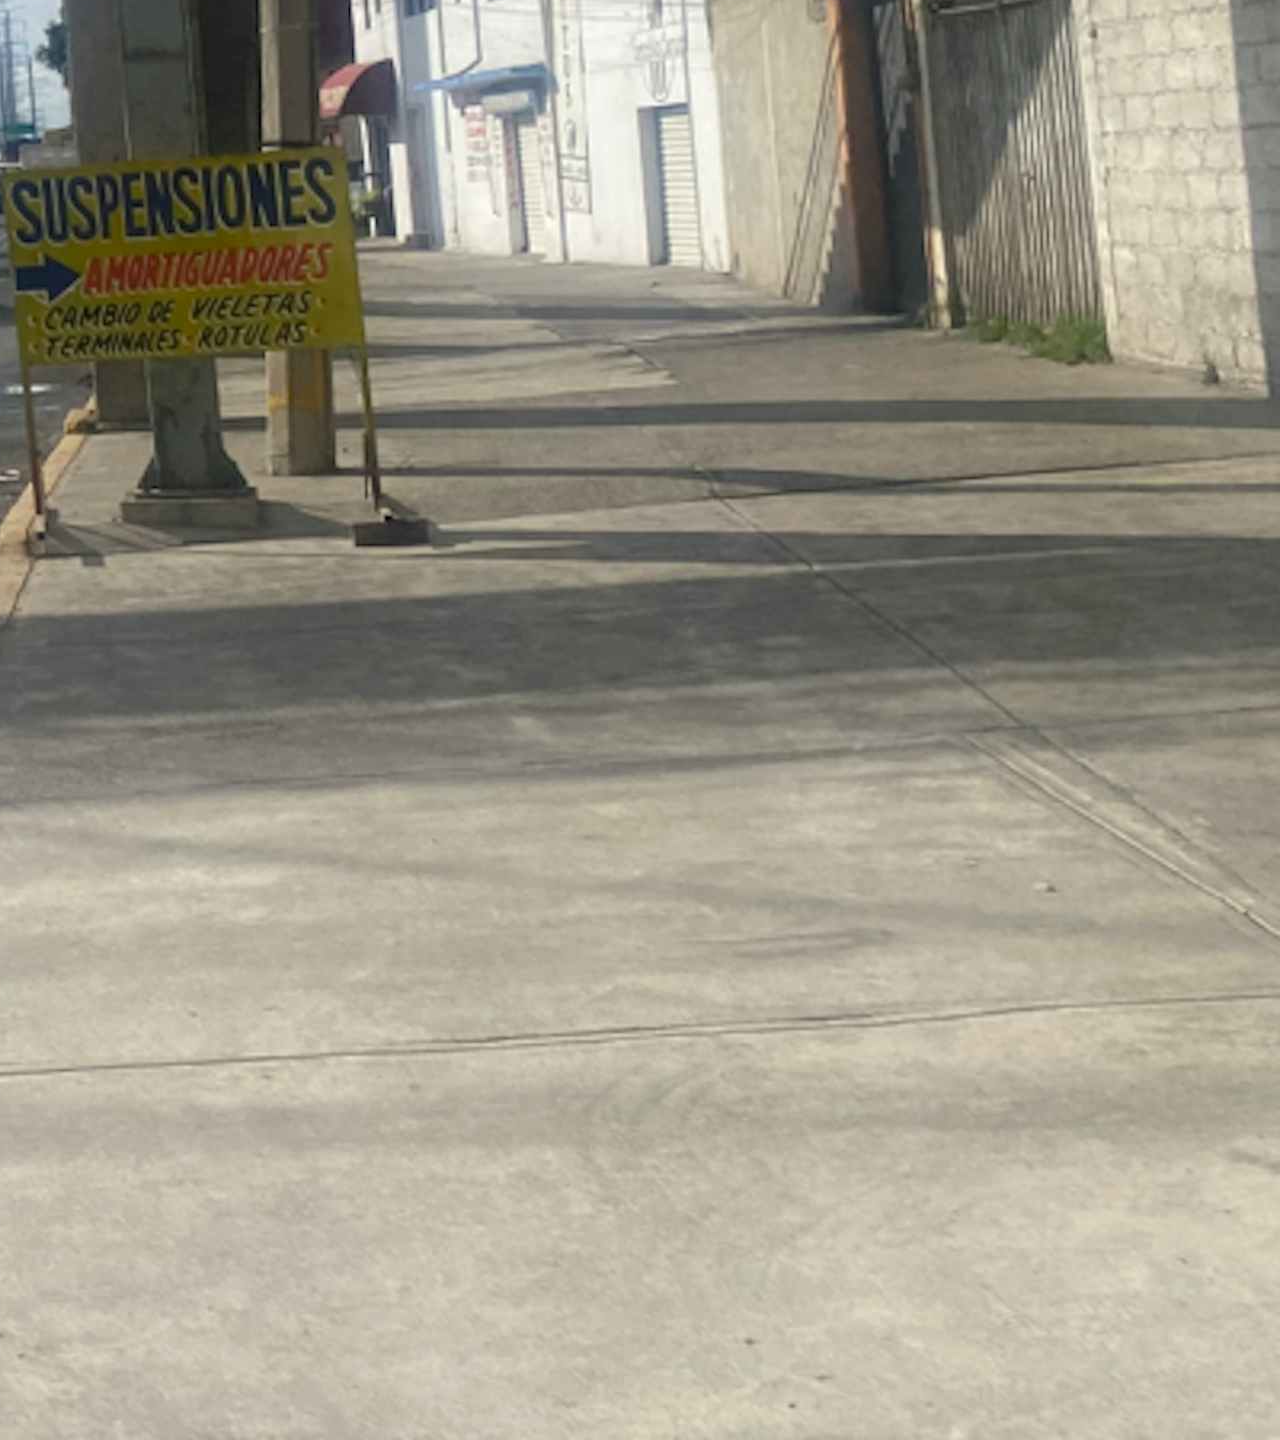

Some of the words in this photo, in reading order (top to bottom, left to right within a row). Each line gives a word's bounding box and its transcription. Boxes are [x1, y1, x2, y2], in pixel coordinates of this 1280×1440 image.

[11, 159, 338, 244] SUSPENSIONES
[83, 243, 332, 294] AMORTIGUADORES
[43, 302, 141, 331] CAMBIO
[146, 299, 177, 324] DE
[46, 328, 182, 358] TERMINALES
[197, 320, 308, 349] ROTULAS
